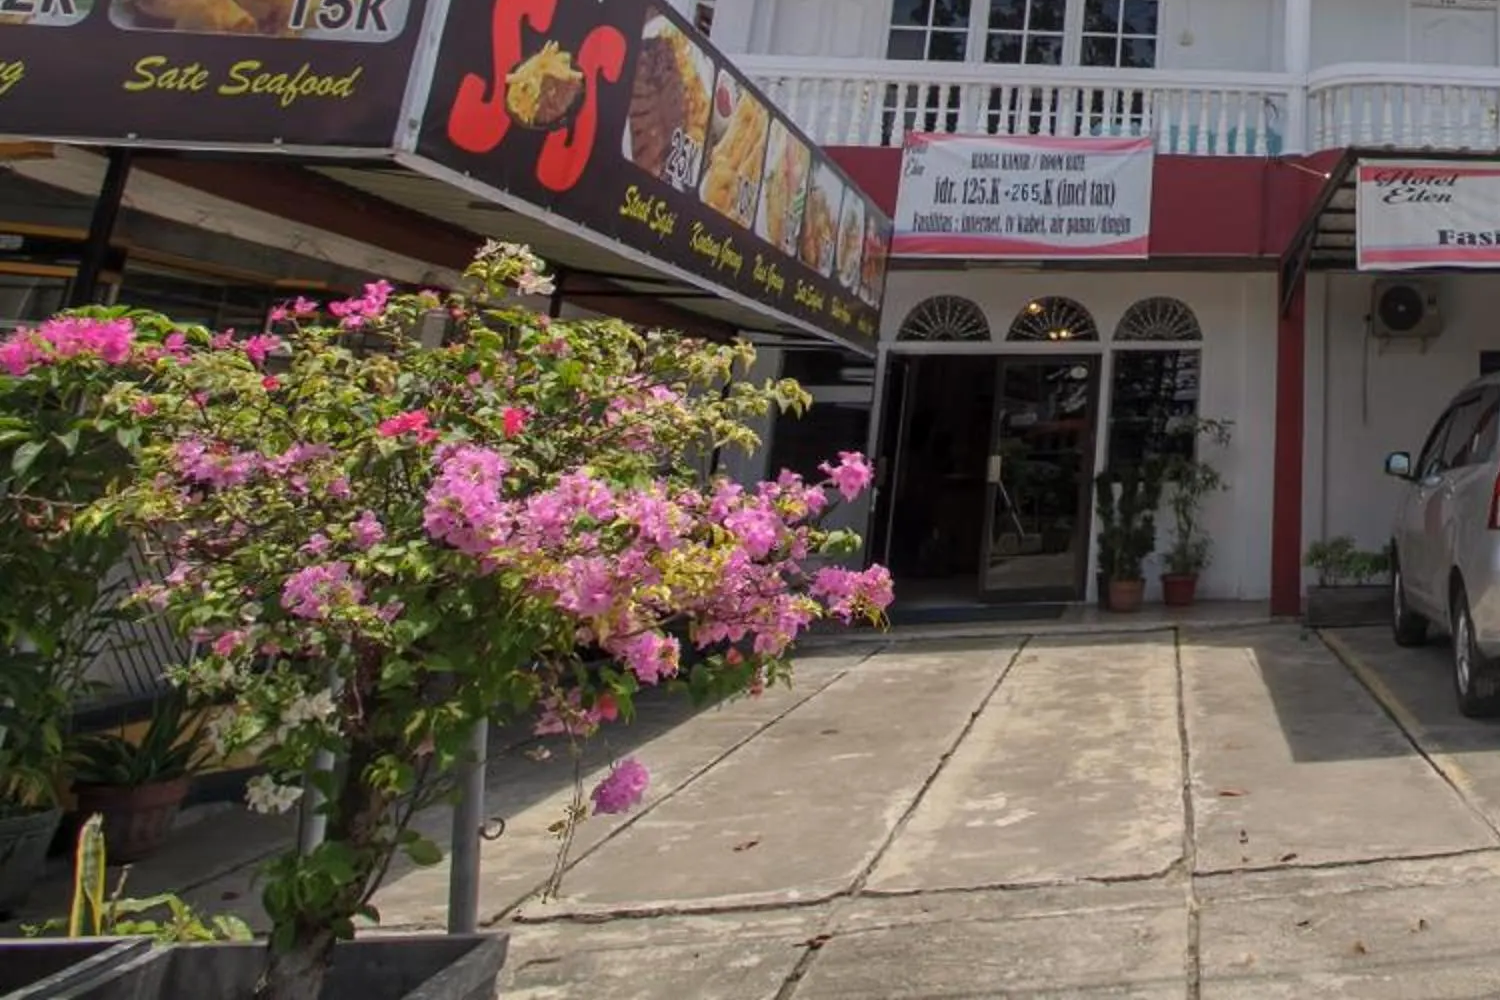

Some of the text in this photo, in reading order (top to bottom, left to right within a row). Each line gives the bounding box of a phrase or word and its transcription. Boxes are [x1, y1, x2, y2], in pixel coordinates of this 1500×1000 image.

[123, 55, 364, 107] Sate Seafood
[1373, 170, 1460, 188] Hotel
